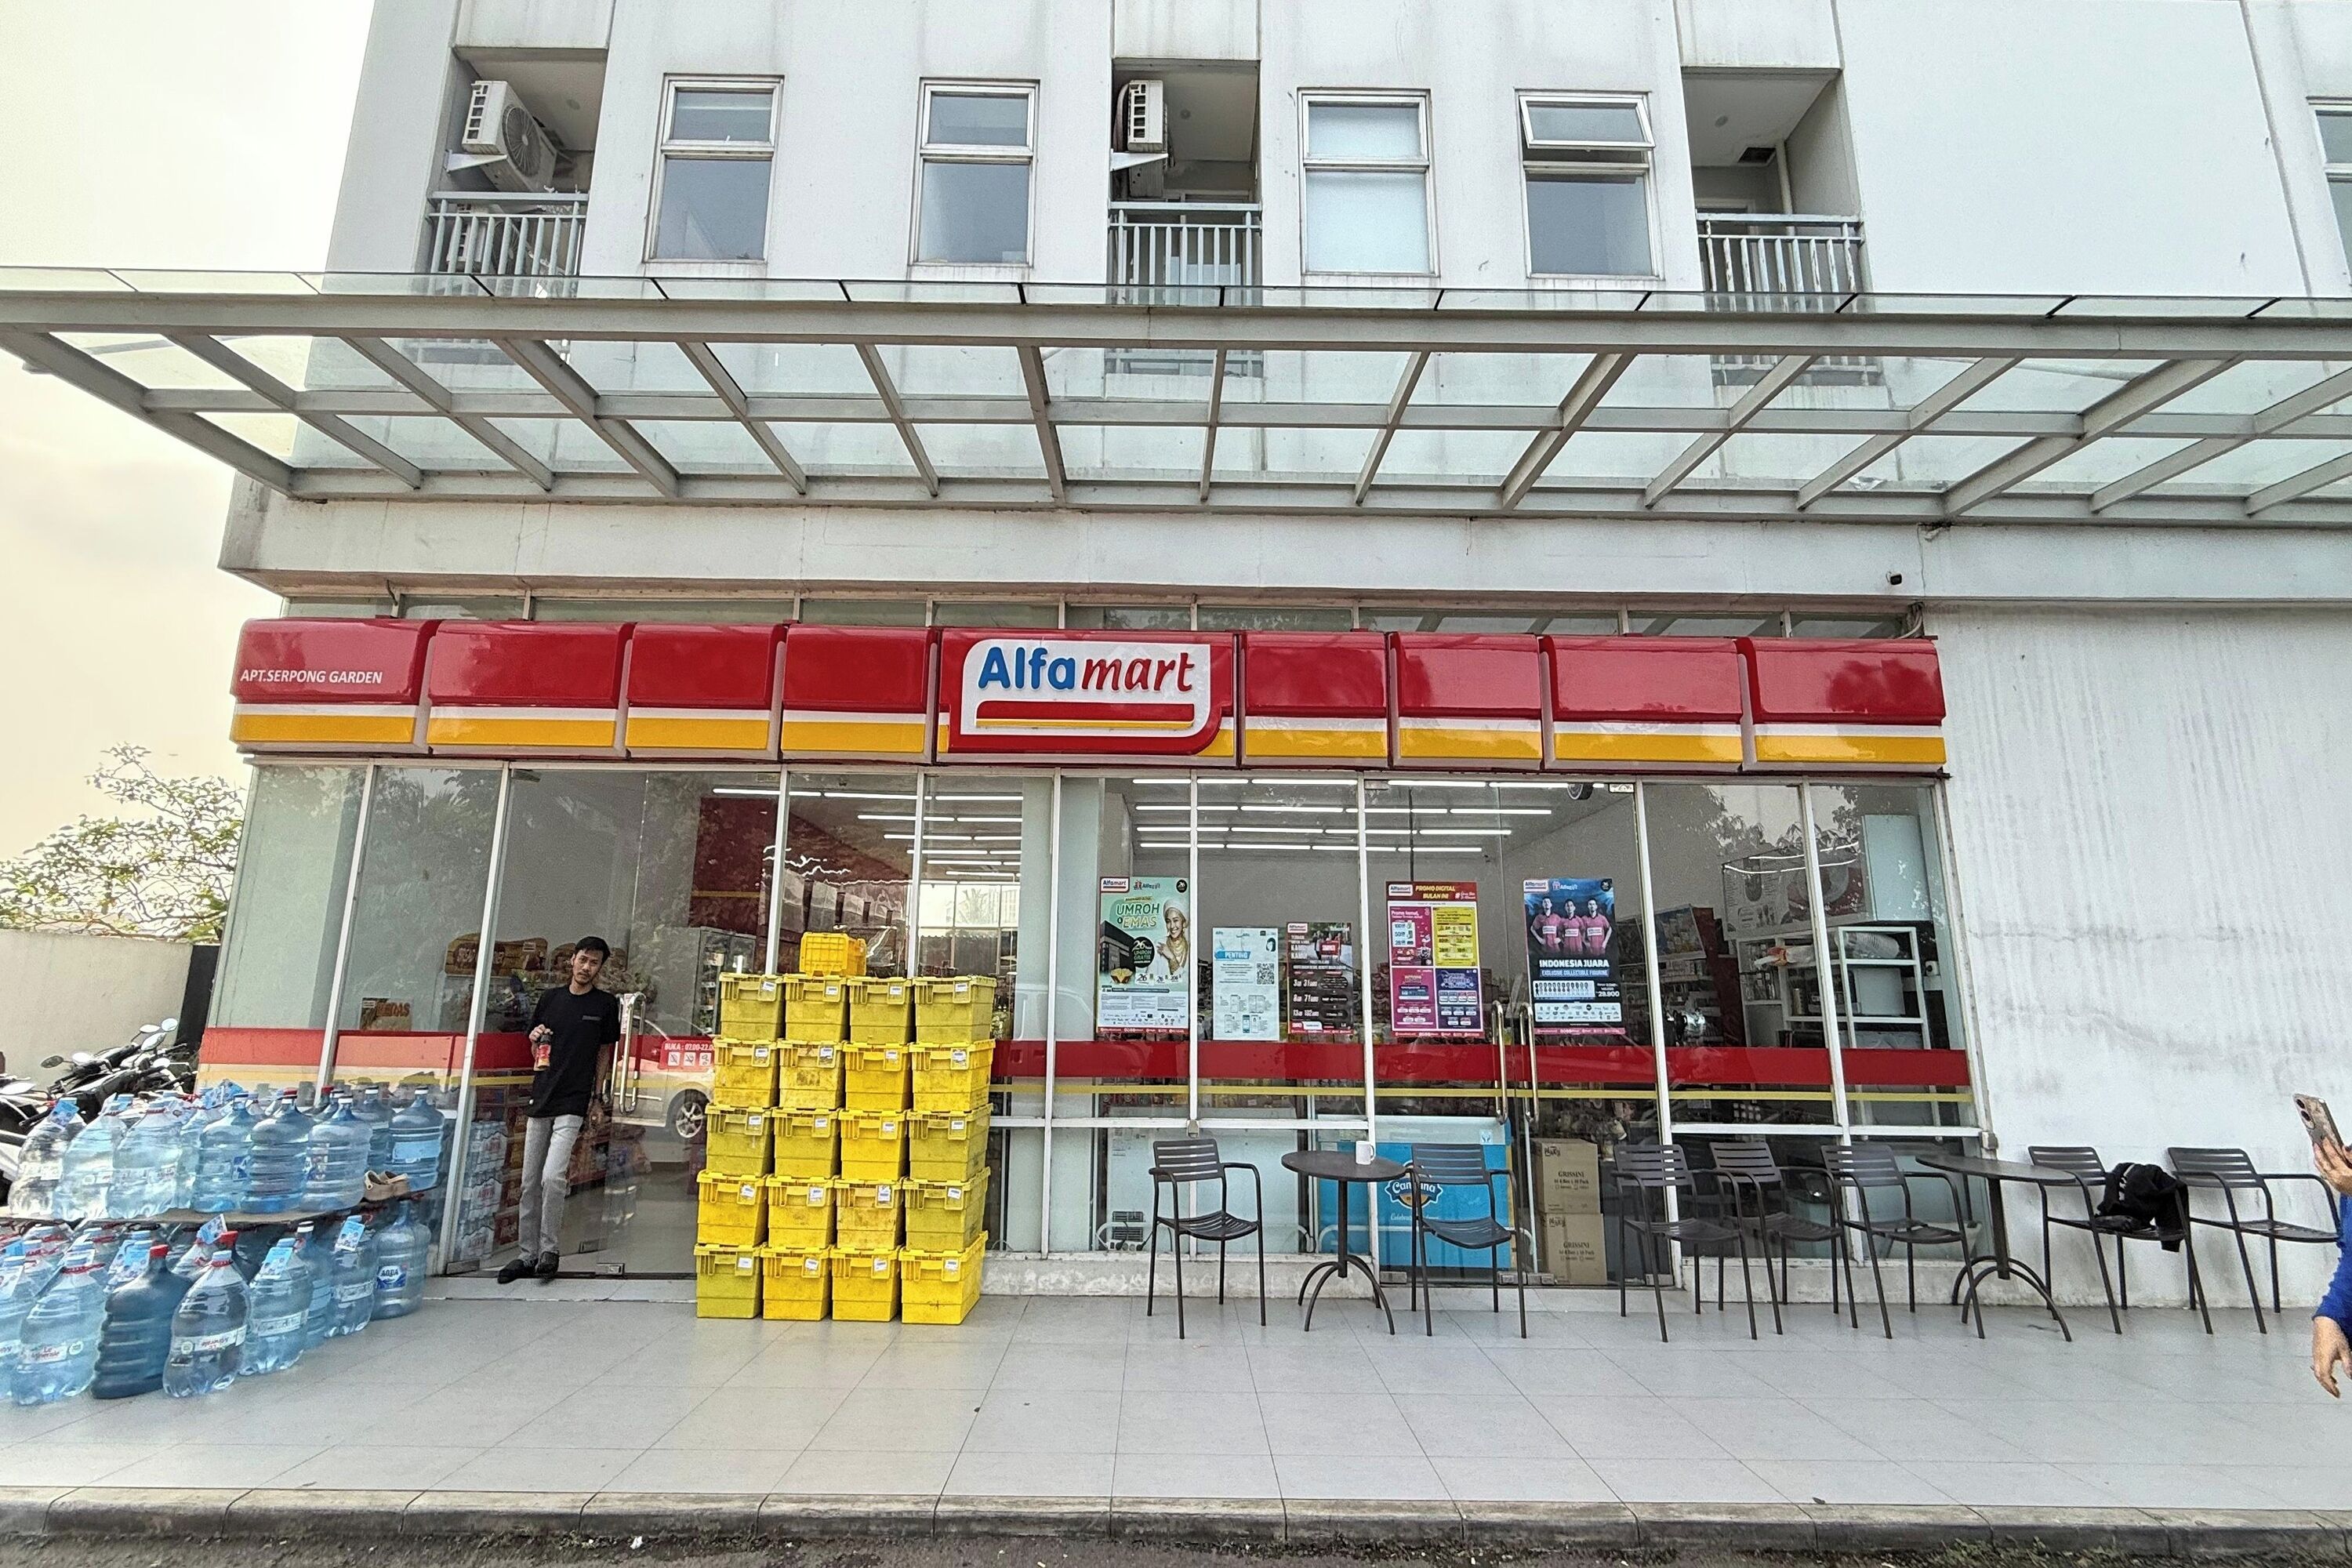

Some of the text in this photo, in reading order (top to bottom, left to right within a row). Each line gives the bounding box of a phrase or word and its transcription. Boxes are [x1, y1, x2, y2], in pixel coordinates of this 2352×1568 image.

[977, 646, 1196, 693] Alfamart
[239, 669, 383, 684] APT.SERPONG GARDEN
[1116, 903, 1160, 916] UMROH
[1123, 916, 1157, 928] EMAS
[1539, 959, 1610, 968] INDONESIA JUARA
[684, 1043, 714, 1051] 07.00-22.0
[1392, 1181, 1436, 1194] Camina
[380, 1269, 399, 1277] AQUA
